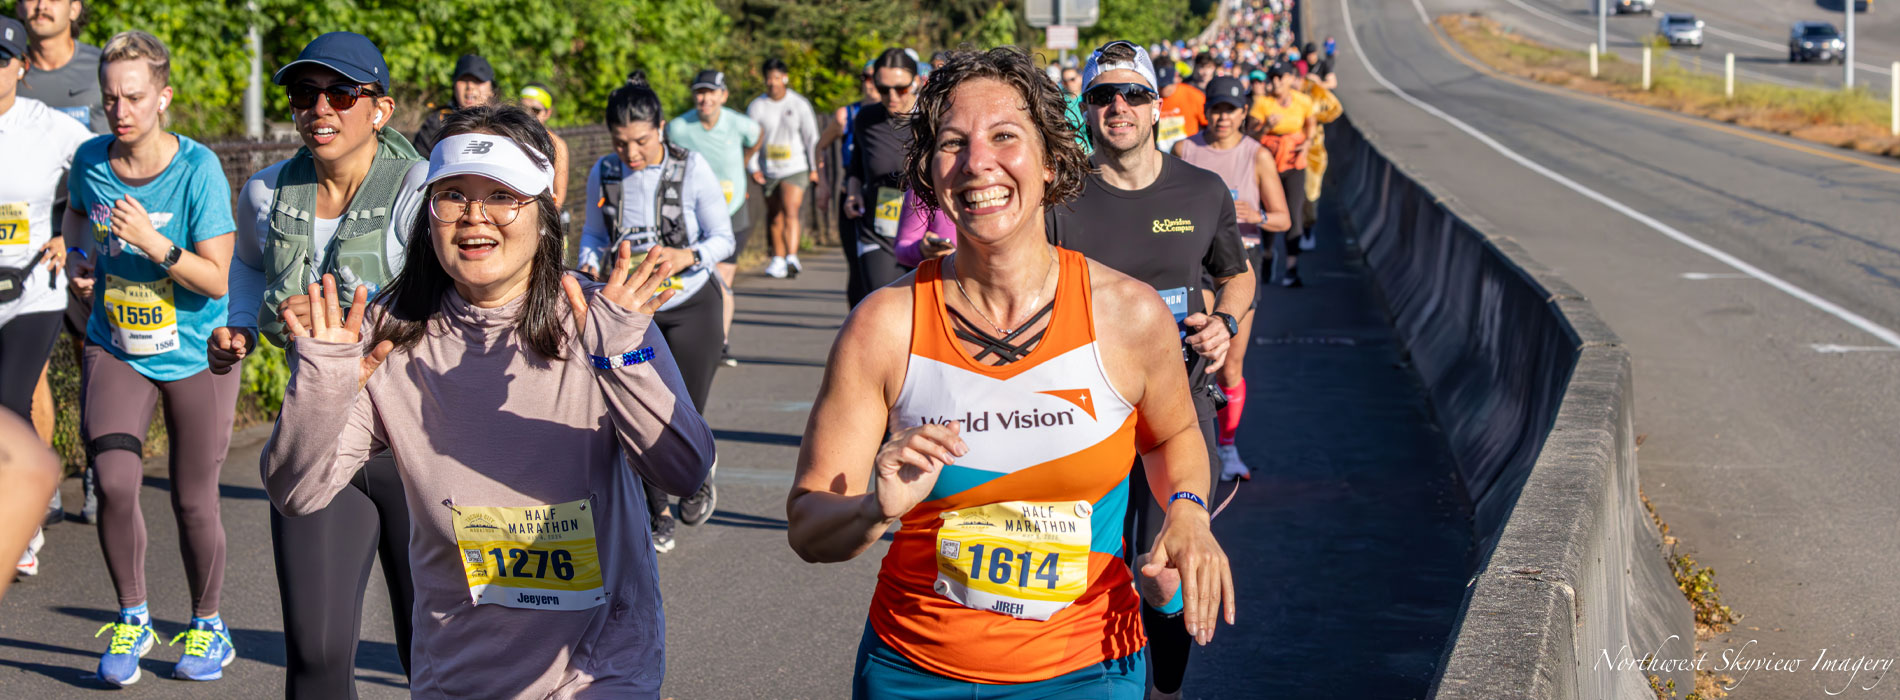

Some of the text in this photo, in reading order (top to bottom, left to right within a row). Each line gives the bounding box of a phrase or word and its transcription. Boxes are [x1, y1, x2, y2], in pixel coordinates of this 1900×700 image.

[117, 304, 163, 326] 1556
[155, 339, 174, 351] 1556
[996, 408, 1075, 430] Vision
[525, 508, 556, 521] HALF
[1022, 505, 1055, 518] HALF
[508, 518, 579, 534] MARATHON
[1005, 519, 1077, 533] MARATHON
[488, 547, 575, 582] 1276
[968, 543, 1060, 590] 1614
[517, 592, 560, 606] Jeeyern
[991, 599, 1025, 615] JIREH
